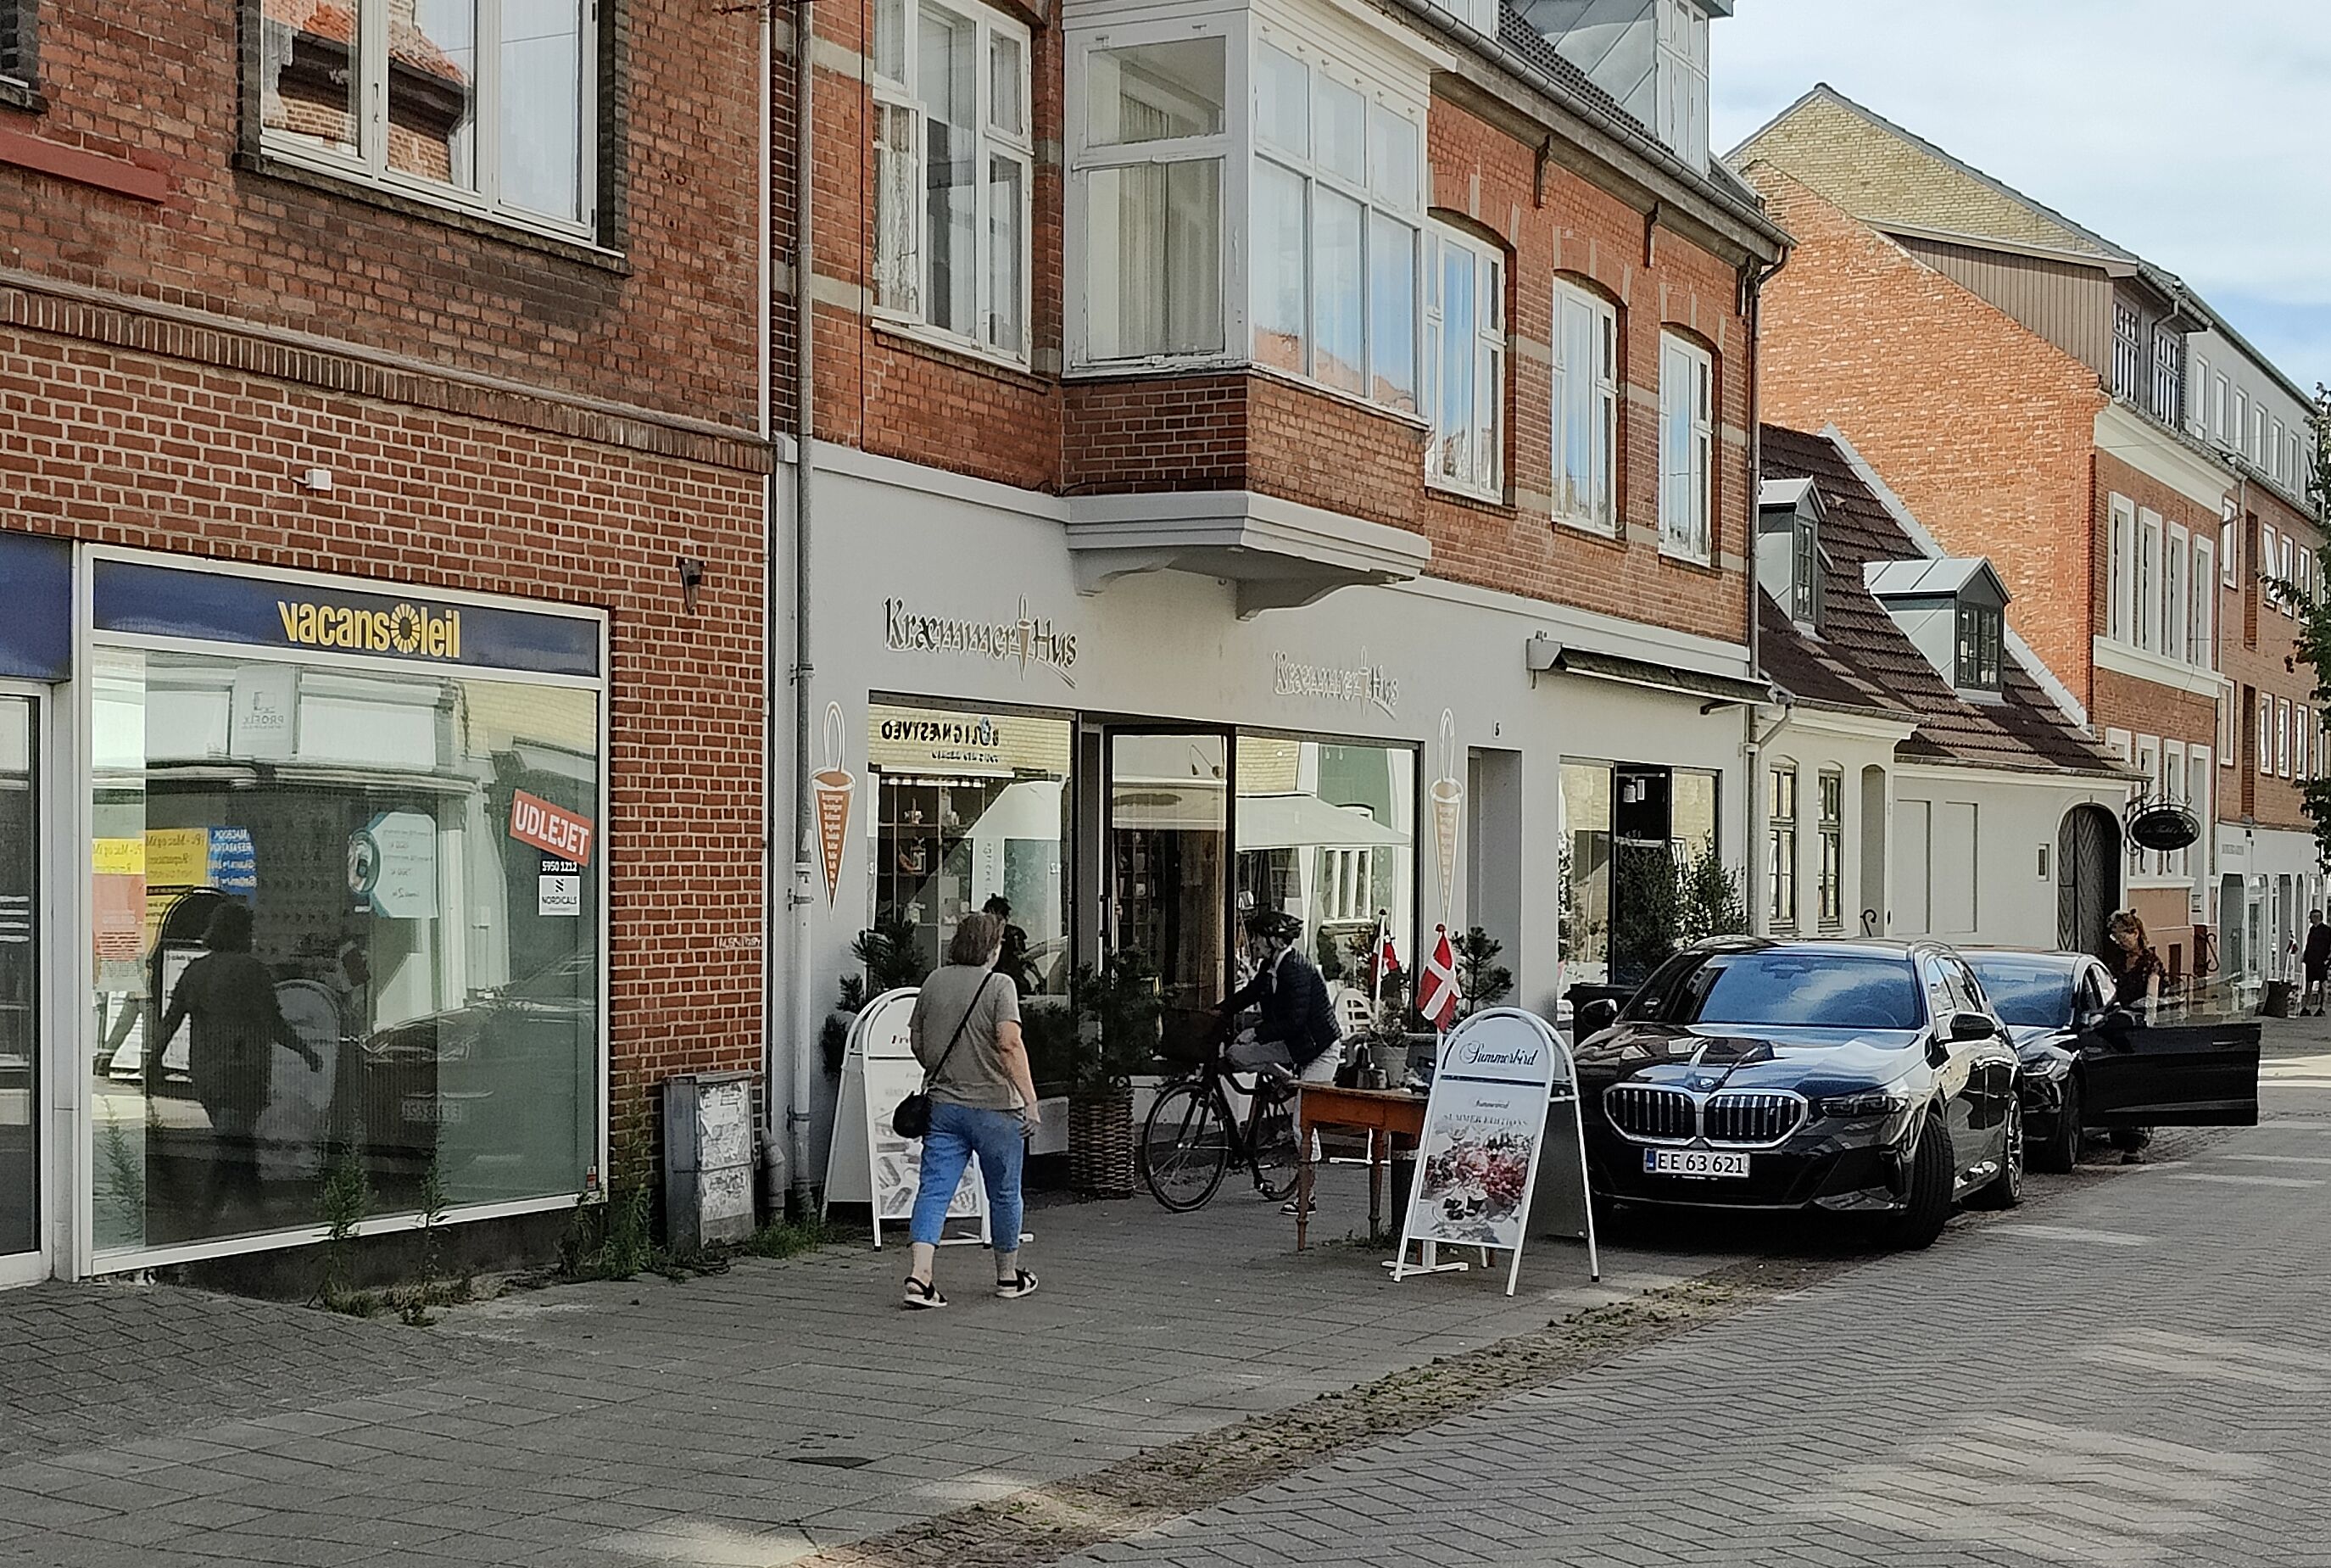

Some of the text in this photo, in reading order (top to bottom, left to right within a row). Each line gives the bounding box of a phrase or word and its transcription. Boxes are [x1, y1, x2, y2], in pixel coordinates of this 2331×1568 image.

[1032, 617, 1079, 669] Hus
[515, 800, 589, 857] UDLEJET
[1458, 1041, 1539, 1066] Summerbird
[1658, 1152, 1744, 1174] EE 63 621
